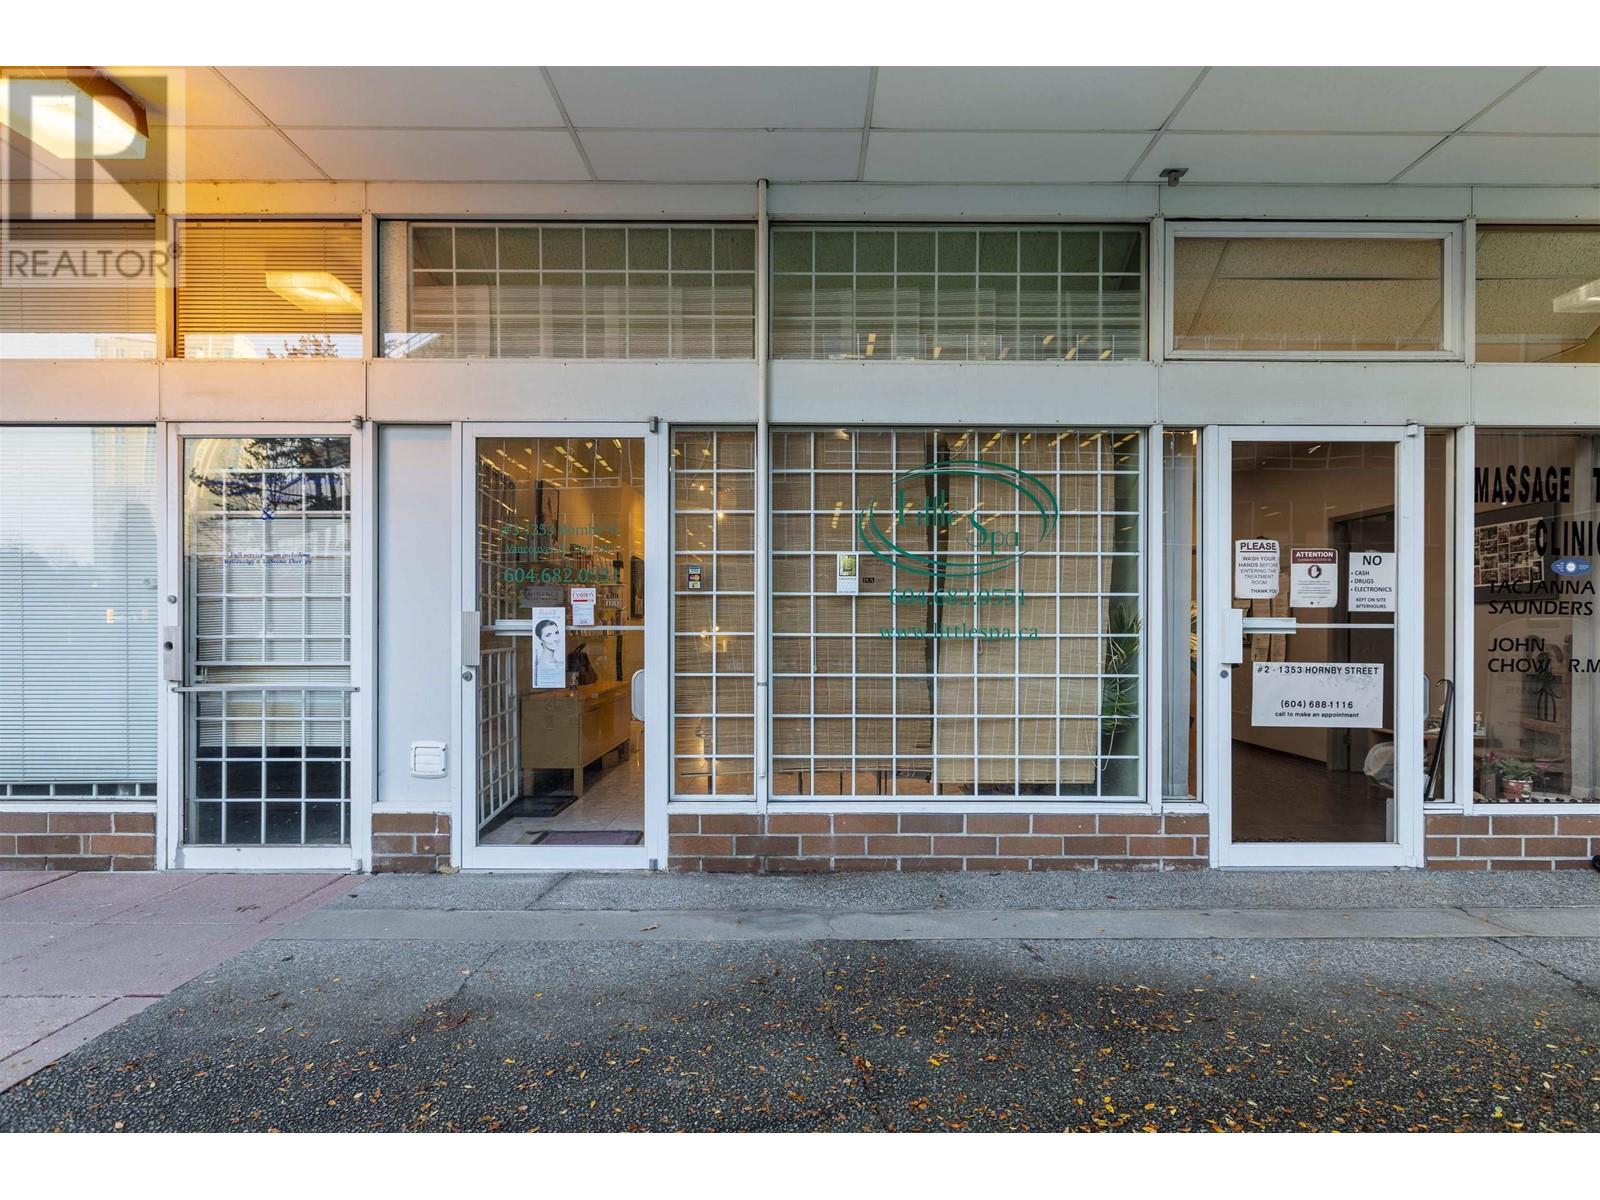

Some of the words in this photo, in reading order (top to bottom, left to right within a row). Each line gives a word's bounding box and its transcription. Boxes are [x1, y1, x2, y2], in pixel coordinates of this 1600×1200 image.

[1475, 465, 1571, 503] MASSAGE
[967, 508, 1020, 555] Spa
[1240, 542, 1277, 551] PLEASE
[1362, 555, 1383, 566] NO
[889, 588, 1025, 606] 604.682.0551
[1488, 601, 1593, 615] SAUNDERS
[879, 622, 1039, 641] www.littlespa.ca
[1488, 638, 1545, 652] JOHN
[1279, 666, 1303, 674] 1353
[1344, 667, 1379, 675] STREET
[1488, 658, 1551, 673] CHOW
[1281, 700, 1306, 708] (604)
[1309, 700, 1354, 709] 688-1116
